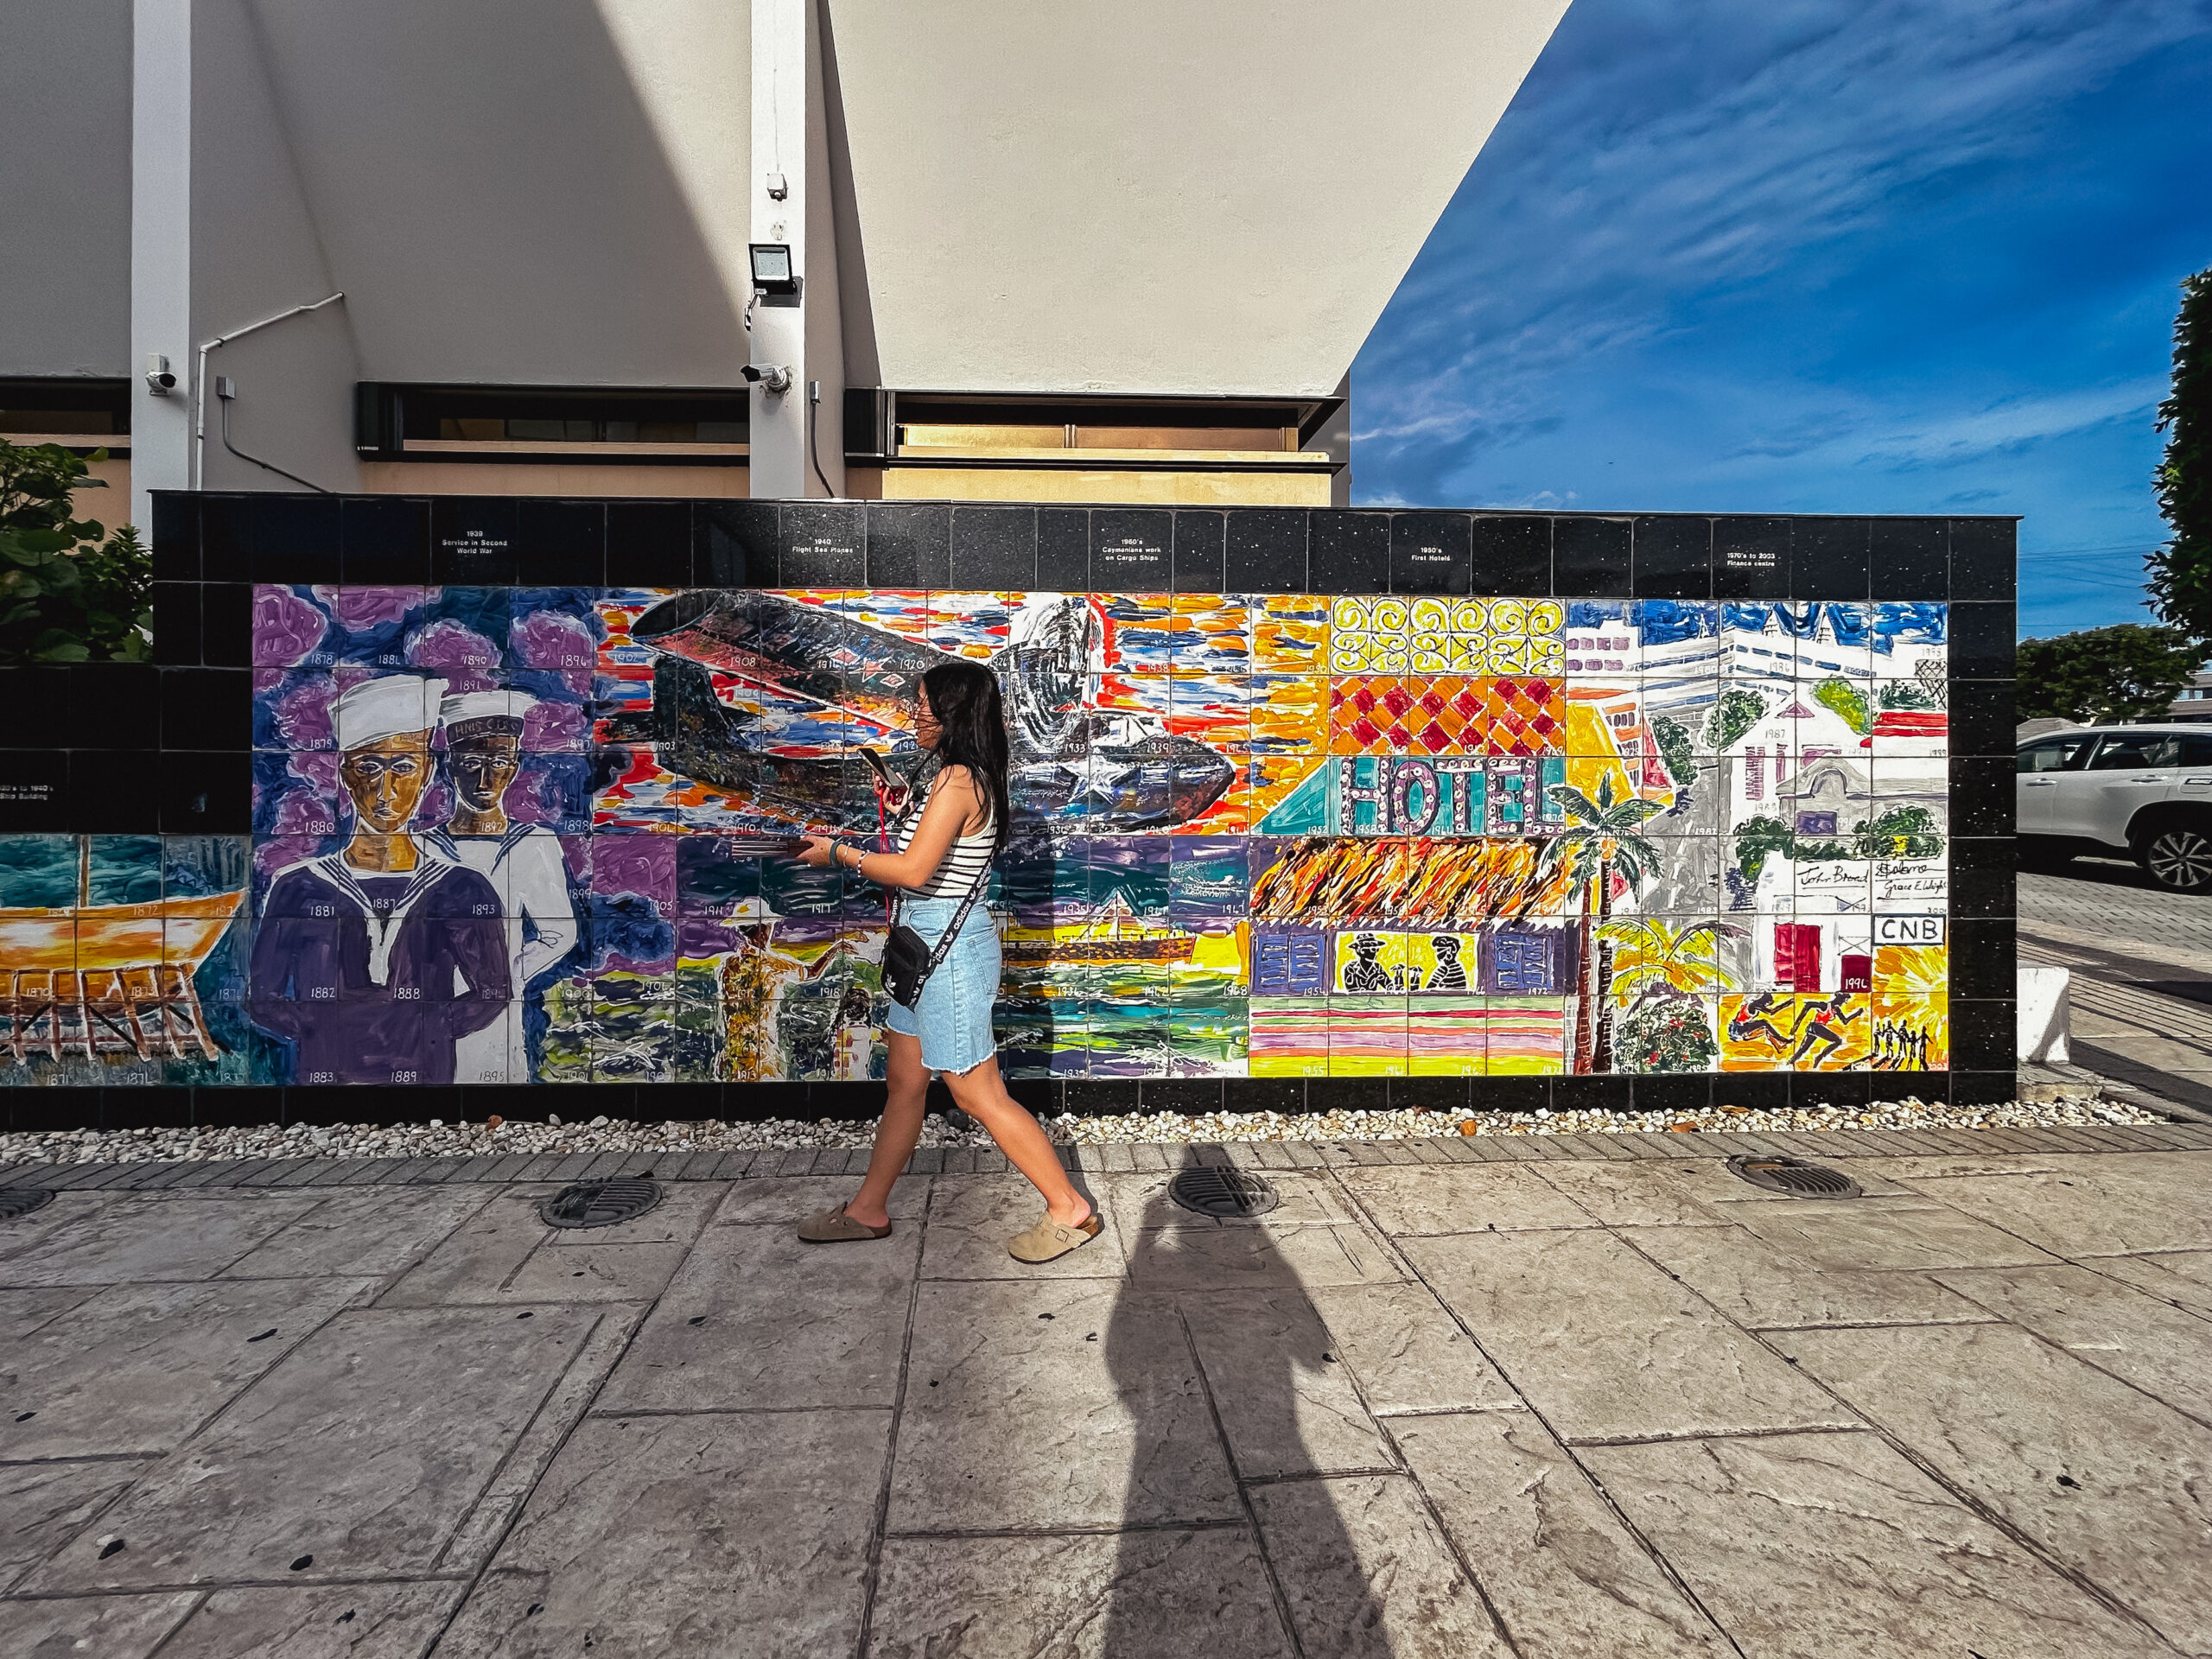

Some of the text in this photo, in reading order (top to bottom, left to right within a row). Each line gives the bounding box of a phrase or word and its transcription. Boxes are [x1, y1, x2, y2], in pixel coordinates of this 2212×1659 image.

[312, 653, 334, 665] 1878
[464, 654, 487, 666] 1890
[730, 656, 757, 668] 1908
[899, 659, 925, 671] 1920
[460, 678, 482, 691] 1891
[1765, 728, 1787, 740] 1987
[310, 738, 332, 751] 1879
[655, 741, 676, 752] 1903
[1064, 742, 1086, 753] 1933
[1147, 743, 1170, 754] 1939
[1340, 756, 1563, 836] HOTEL
[304, 819, 335, 833] 1880
[480, 821, 505, 834] 1892
[563, 819, 589, 833] 1898
[1307, 826, 1327, 836] 1952
[1355, 823, 1377, 835] 1958
[976, 861, 991, 888] adidas
[569, 887, 592, 900] 1899
[1884, 880, 1911, 899] Grace
[373, 898, 396, 910] 1887
[472, 903, 495, 916] 1893
[649, 900, 674, 912] 1905
[810, 904, 831, 915] 1917
[1064, 904, 1086, 916] 1935
[134, 905, 159, 917] 1872
[309, 905, 334, 918] 1881
[703, 905, 723, 916] 1911
[953, 901, 971, 930] adidas
[1881, 918, 1938, 940] CNB
[26, 987, 51, 998] 1870
[131, 987, 157, 998] 1873
[311, 986, 336, 999] 1882
[393, 987, 422, 1000] 1888
[562, 988, 591, 999] 1900
[820, 987, 842, 999] 1918
[1527, 987, 1549, 996] 1972
[1301, 1066, 1325, 1077] 1955
[1688, 1063, 1709, 1073] 1985
[47, 1072, 70, 1086] 1871
[308, 1071, 334, 1084] 1883
[390, 1070, 418, 1083] 1889
[479, 1070, 505, 1083] 1895
[567, 1071, 590, 1082] 1901
[736, 1070, 756, 1081] 1913
